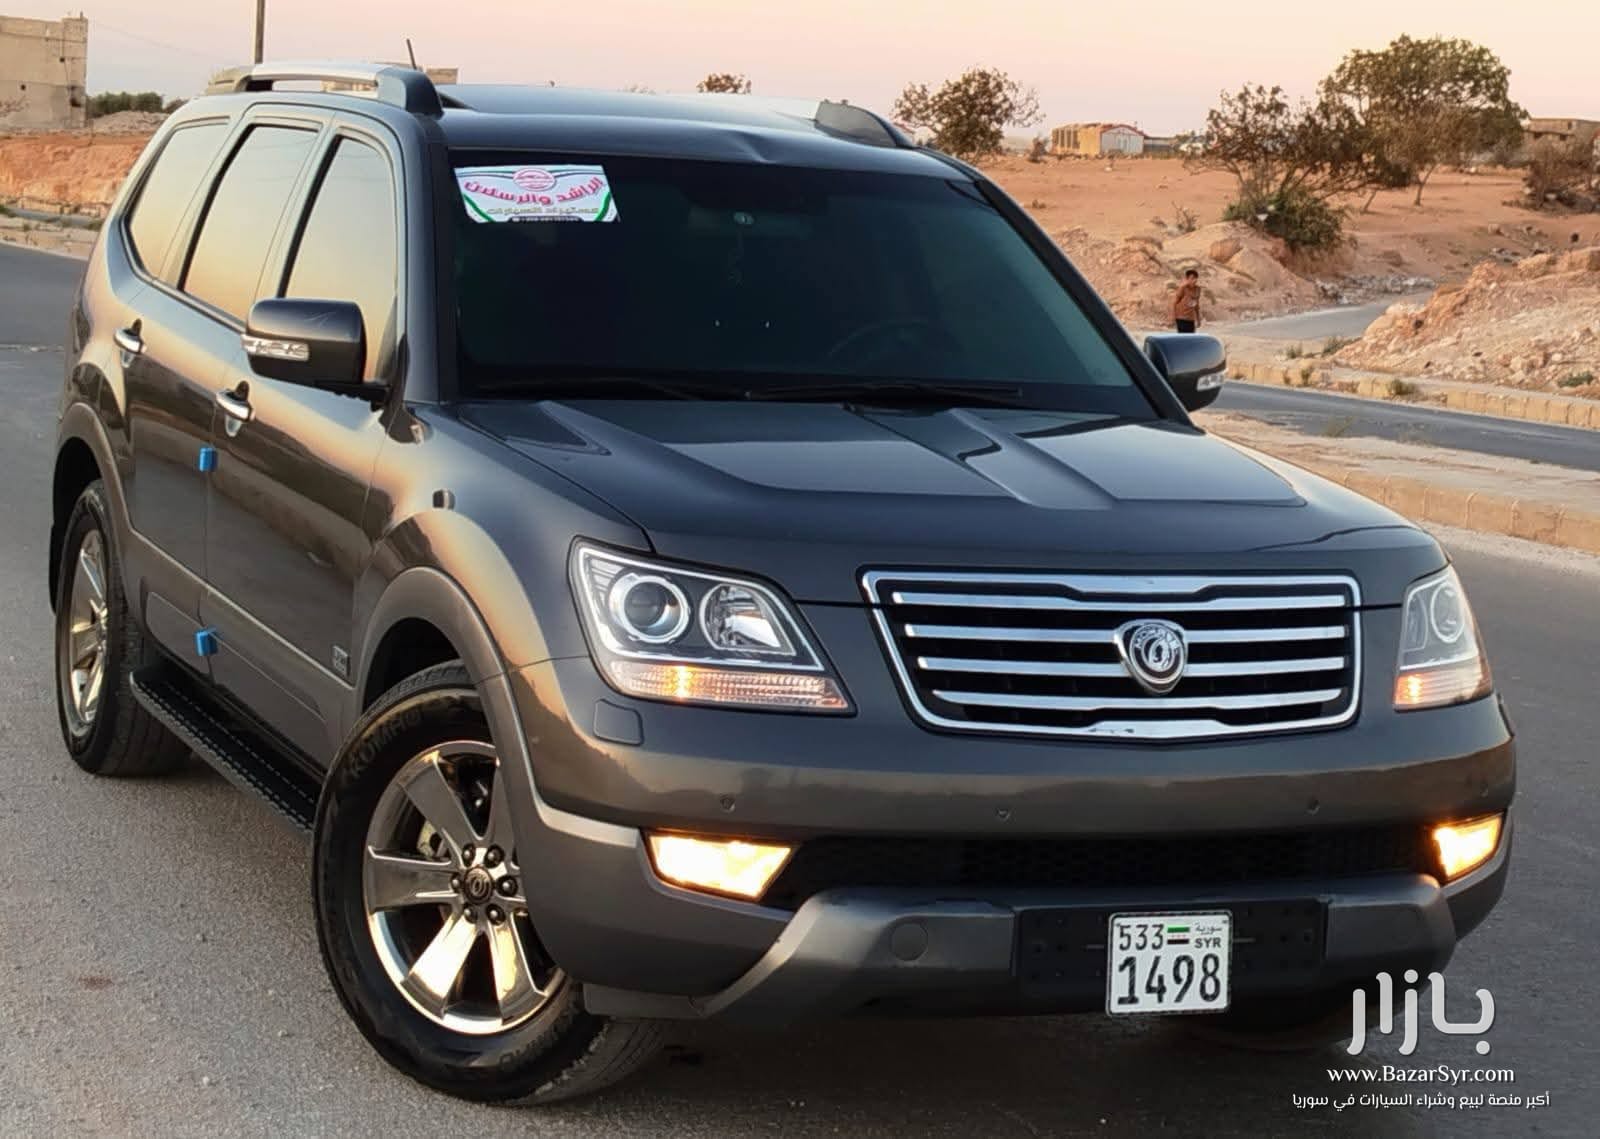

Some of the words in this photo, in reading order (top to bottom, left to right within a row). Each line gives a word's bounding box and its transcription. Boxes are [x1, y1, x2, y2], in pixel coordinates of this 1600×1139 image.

[1118, 923, 1165, 951] 533
[1194, 937, 1222, 949] SYR
[1117, 953, 1221, 1006] 1498
